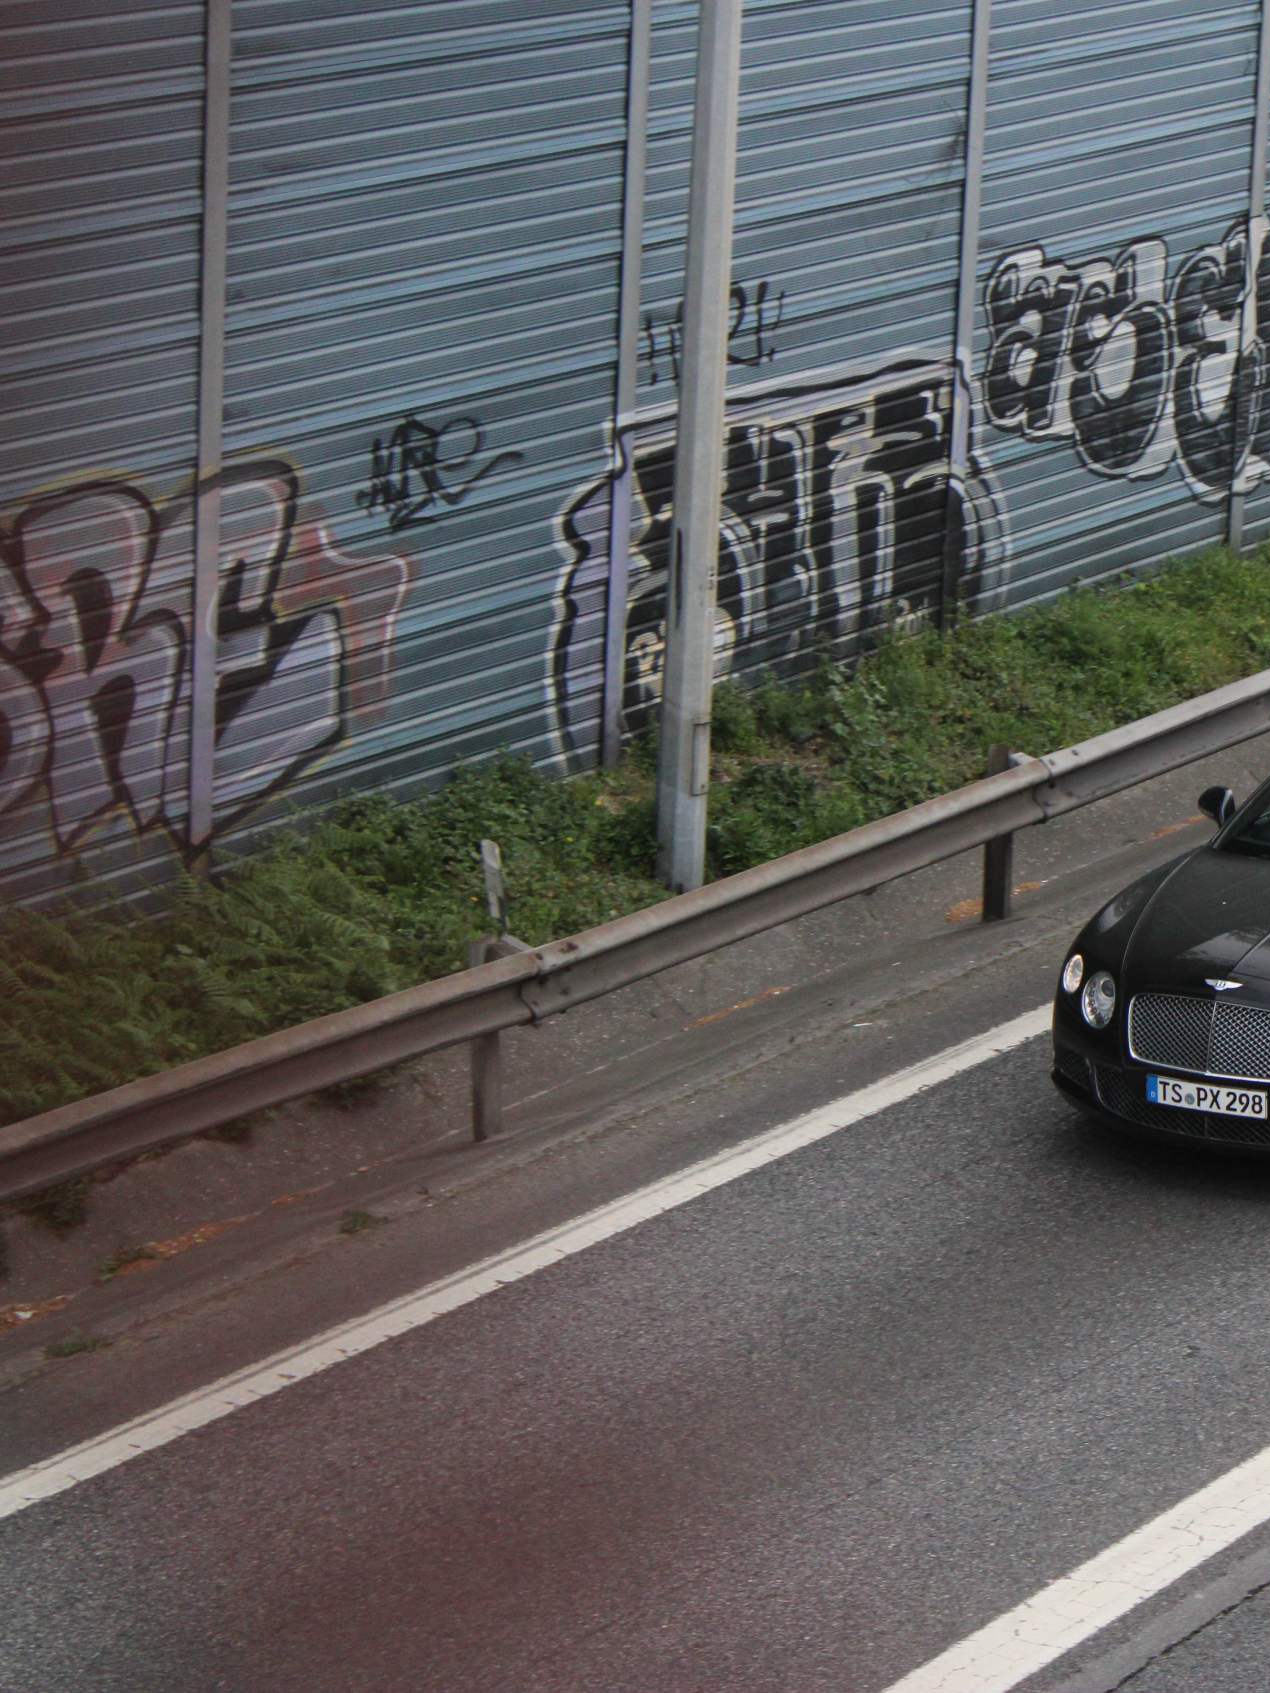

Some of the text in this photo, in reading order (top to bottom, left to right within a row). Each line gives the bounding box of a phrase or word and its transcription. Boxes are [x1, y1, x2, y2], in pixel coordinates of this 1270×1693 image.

[1159, 1081, 1263, 1114] TS PX 298
